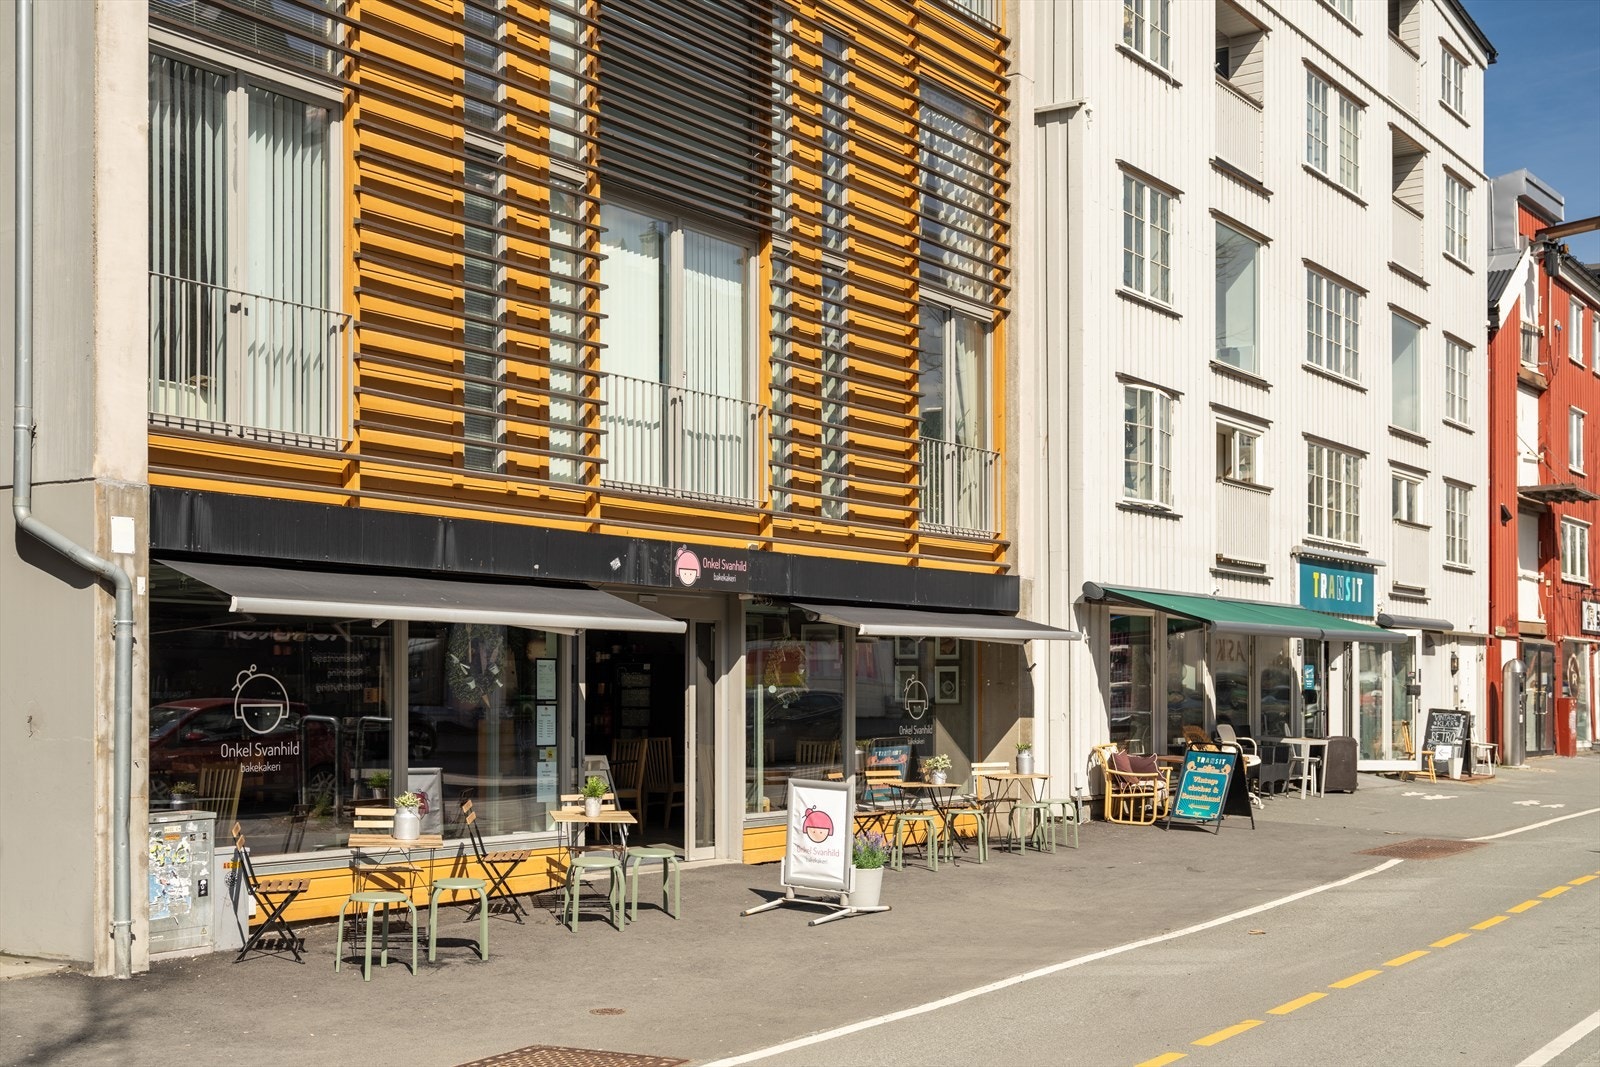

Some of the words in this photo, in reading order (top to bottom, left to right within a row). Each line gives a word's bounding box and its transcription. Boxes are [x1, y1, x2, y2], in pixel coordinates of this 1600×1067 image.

[702, 557, 720, 570] Onkel
[721, 558, 747, 572] Svanhild
[713, 572, 737, 582] bakekakeri
[1313, 571, 1363, 603] TRANSIT
[899, 725, 913, 735] Onkel
[914, 725, 933, 735] Svanhild
[1432, 731, 1456, 743] RETRO
[220, 742, 252, 758] Onkel
[254, 741, 300, 757] Svanhild
[1197, 756, 1226, 765] TRANSIT
[240, 761, 281, 773] bakekakeri
[813, 847, 840, 857] Svanhild
